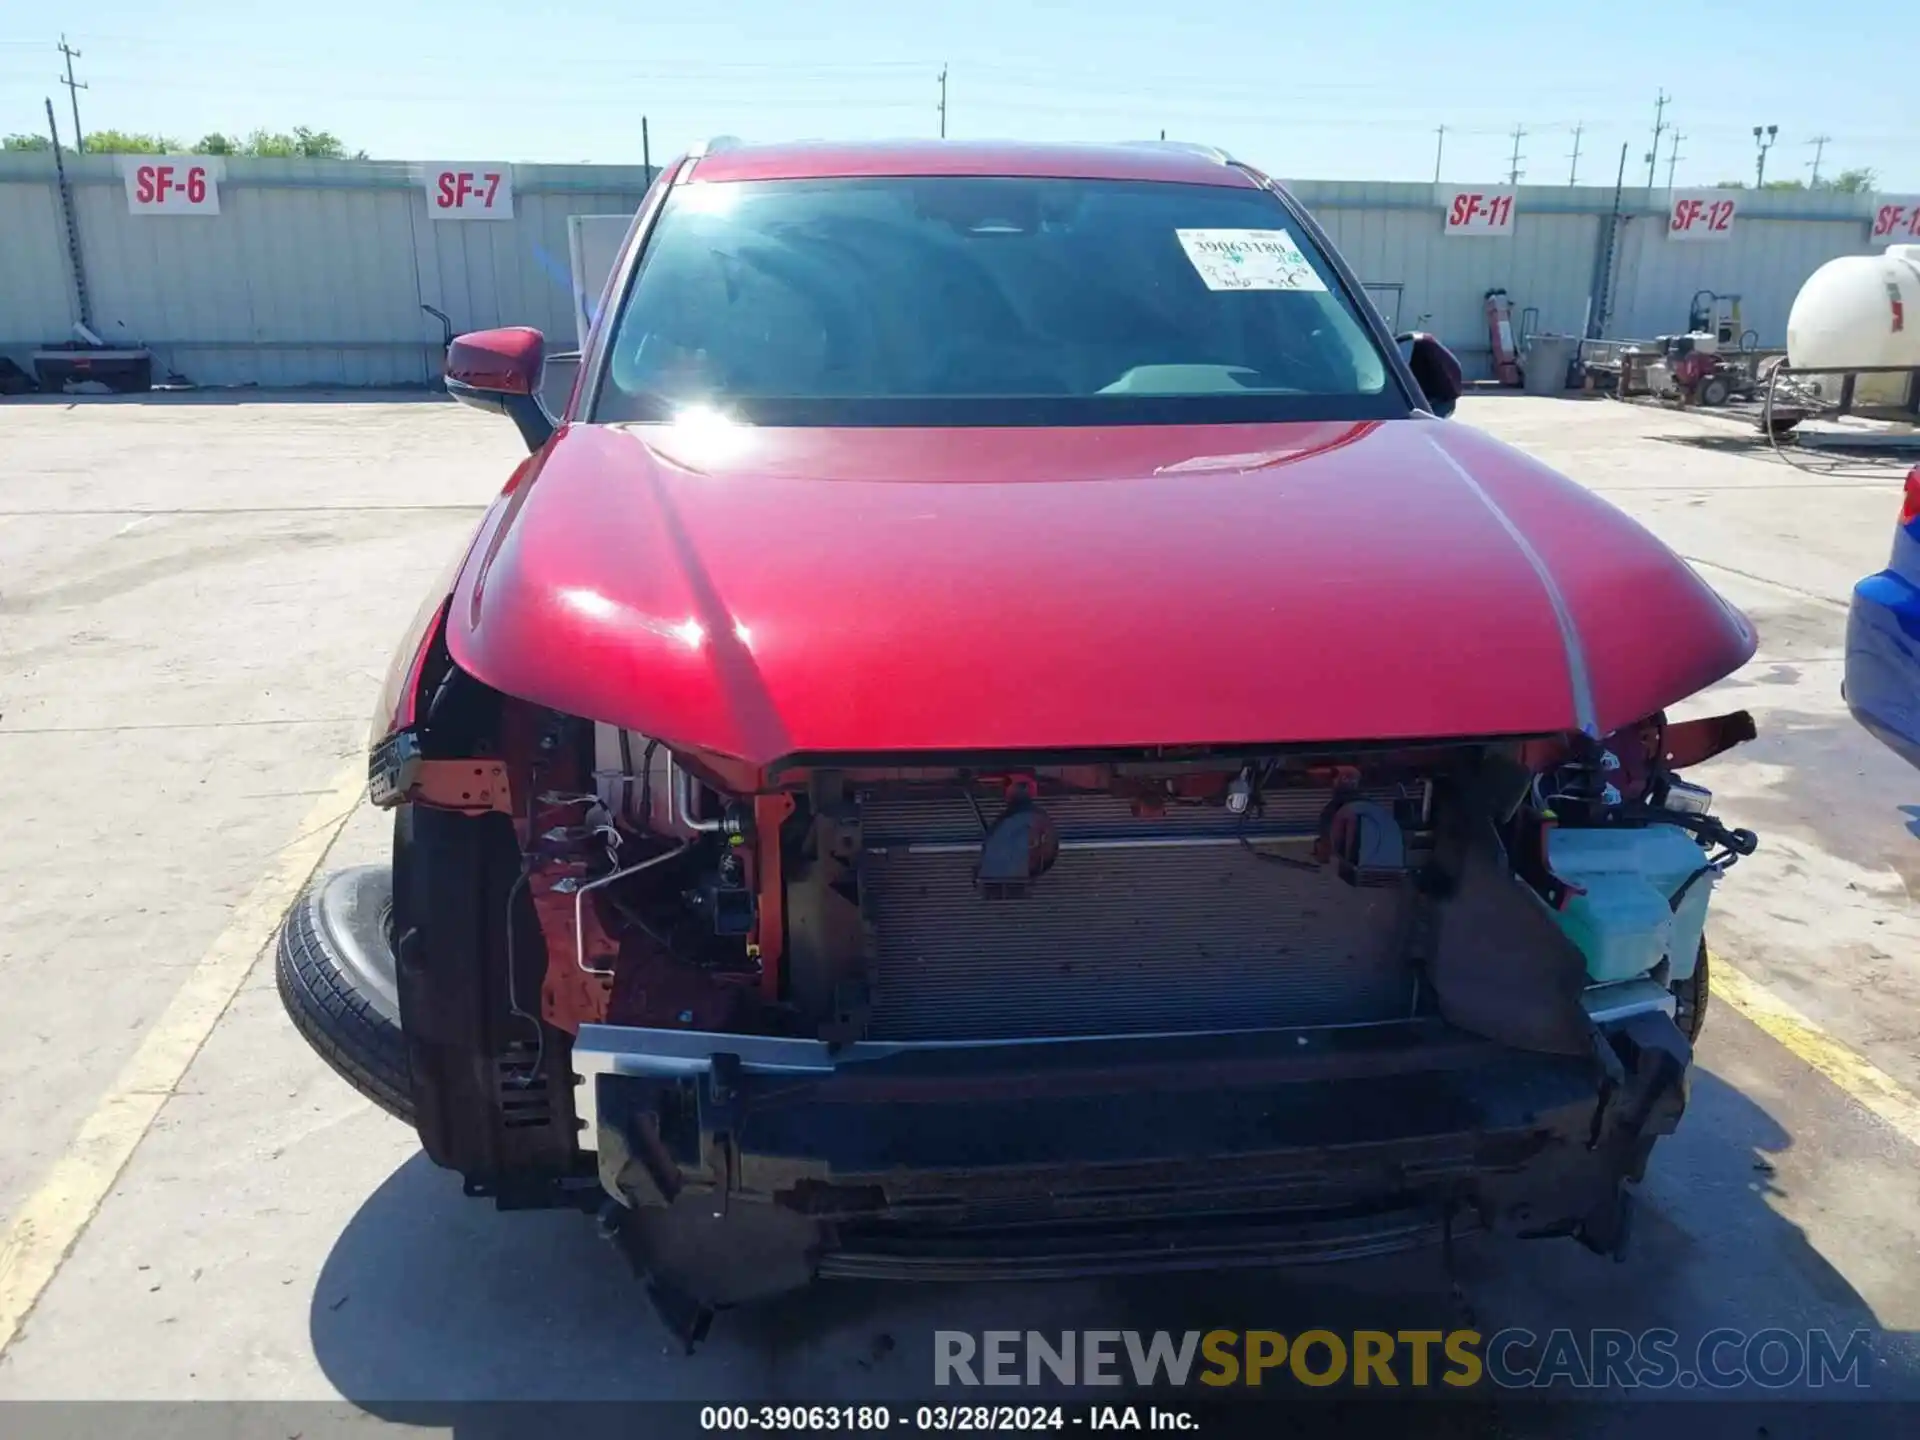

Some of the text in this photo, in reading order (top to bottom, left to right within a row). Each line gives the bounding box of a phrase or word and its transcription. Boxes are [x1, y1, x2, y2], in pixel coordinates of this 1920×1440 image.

[136, 166, 206, 204] SF-6
[437, 171, 501, 208] SF-7
[1450, 194, 1513, 226] SF-11
[1671, 199, 1735, 231] SF-12
[1194, 240, 1286, 254] 39063180
